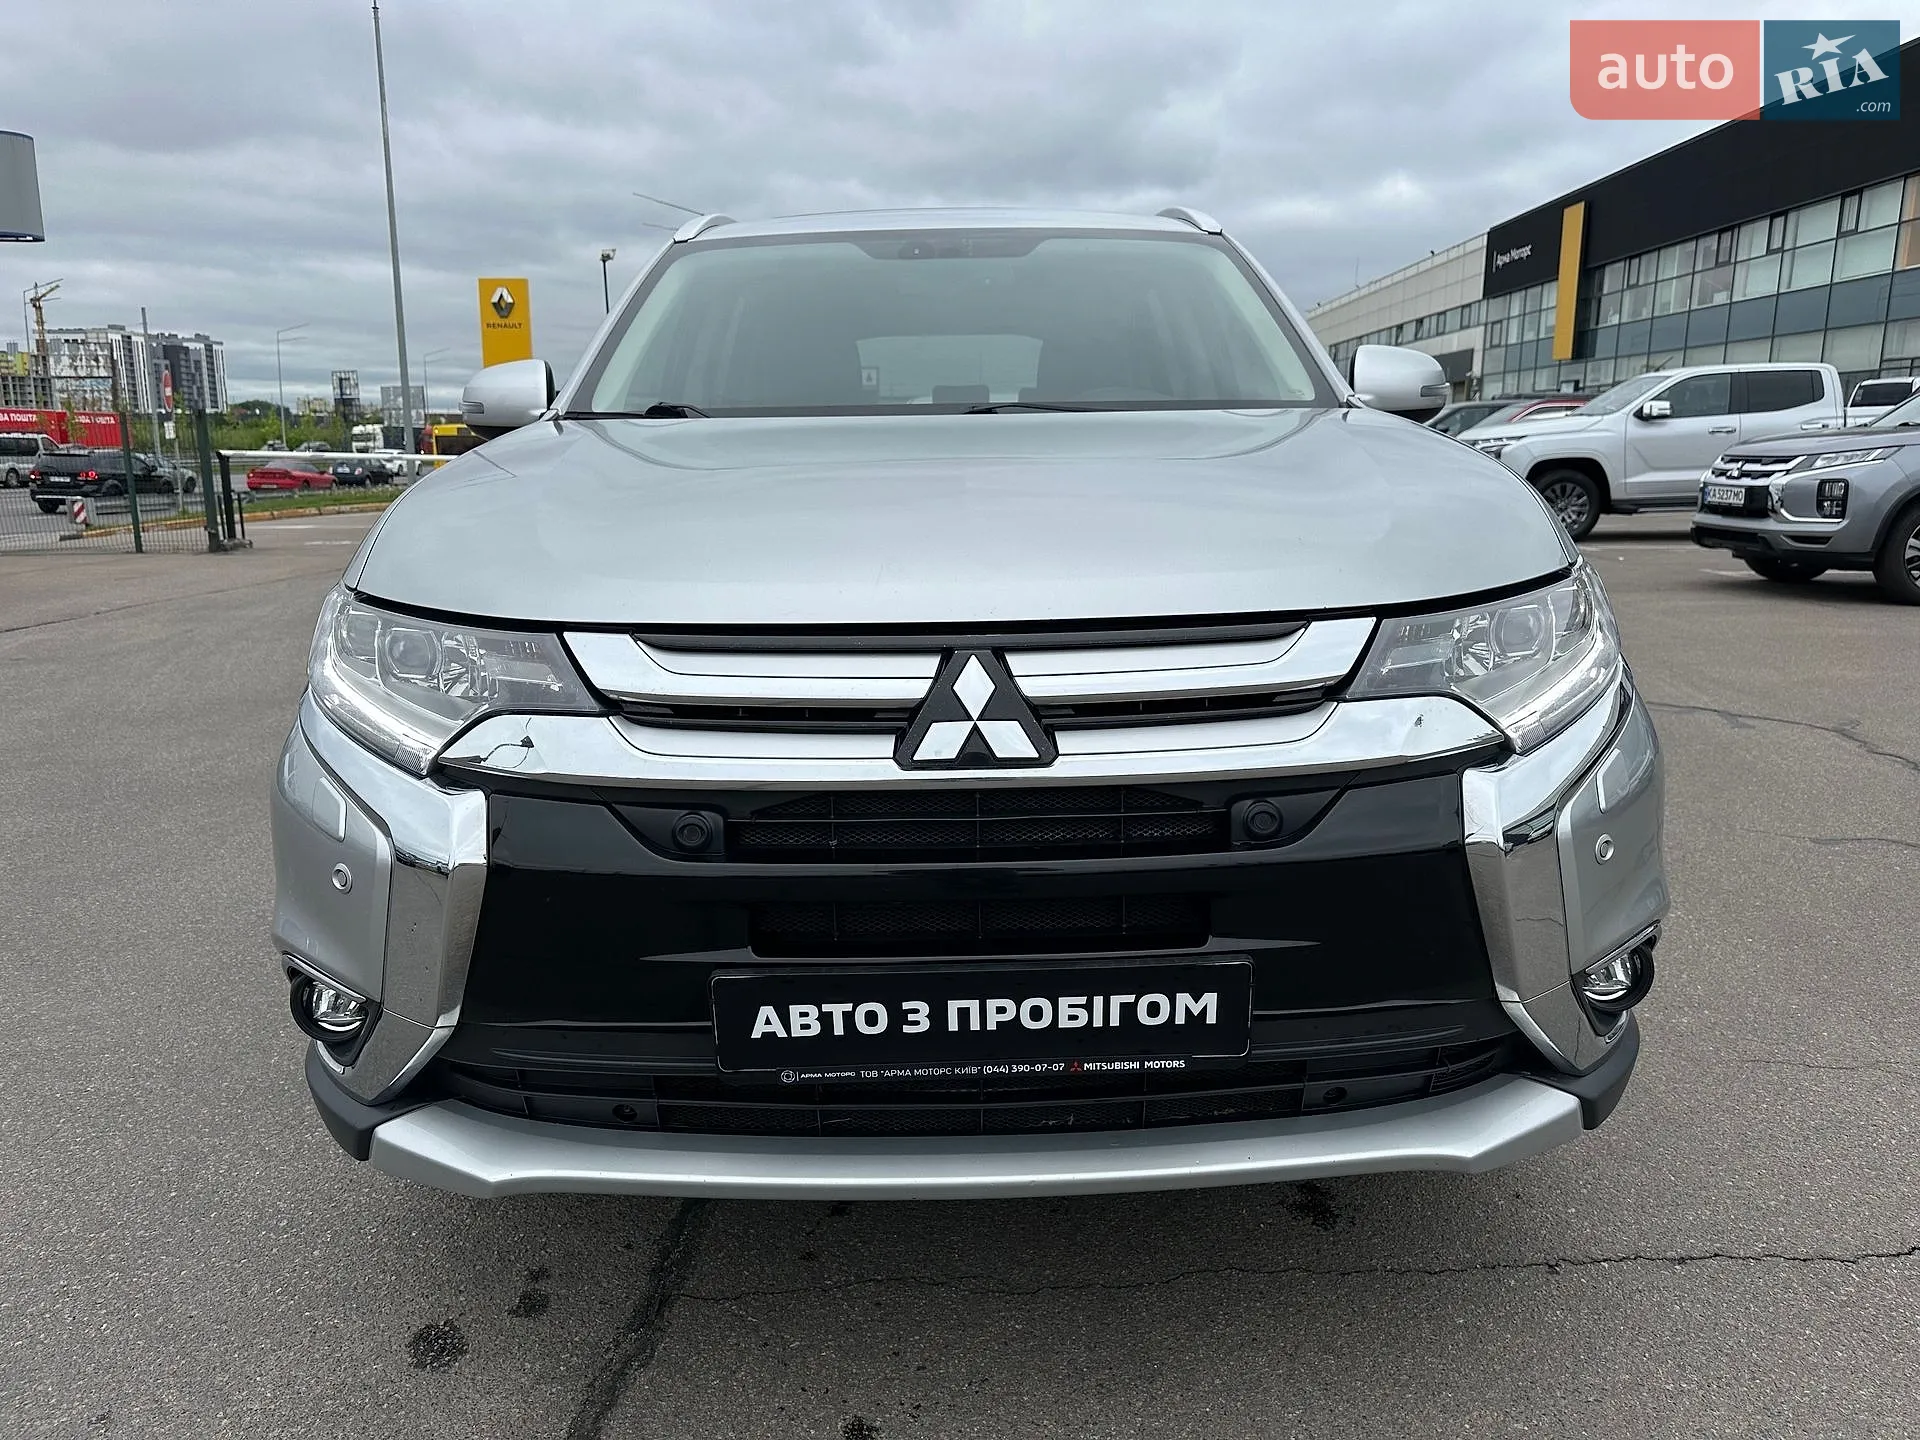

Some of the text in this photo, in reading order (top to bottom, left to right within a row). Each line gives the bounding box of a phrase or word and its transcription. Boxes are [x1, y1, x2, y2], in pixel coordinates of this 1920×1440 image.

[750, 1002, 888, 1039] АВТО
[947, 992, 1218, 1032] ПРОБІГОМ
[860, 1063, 1065, 1078] ТОВ "АРМА МОТОРС КИЇВ" (044) 390-07-07
[1083, 1060, 1186, 1071] MITSUBISHI MOTORS
